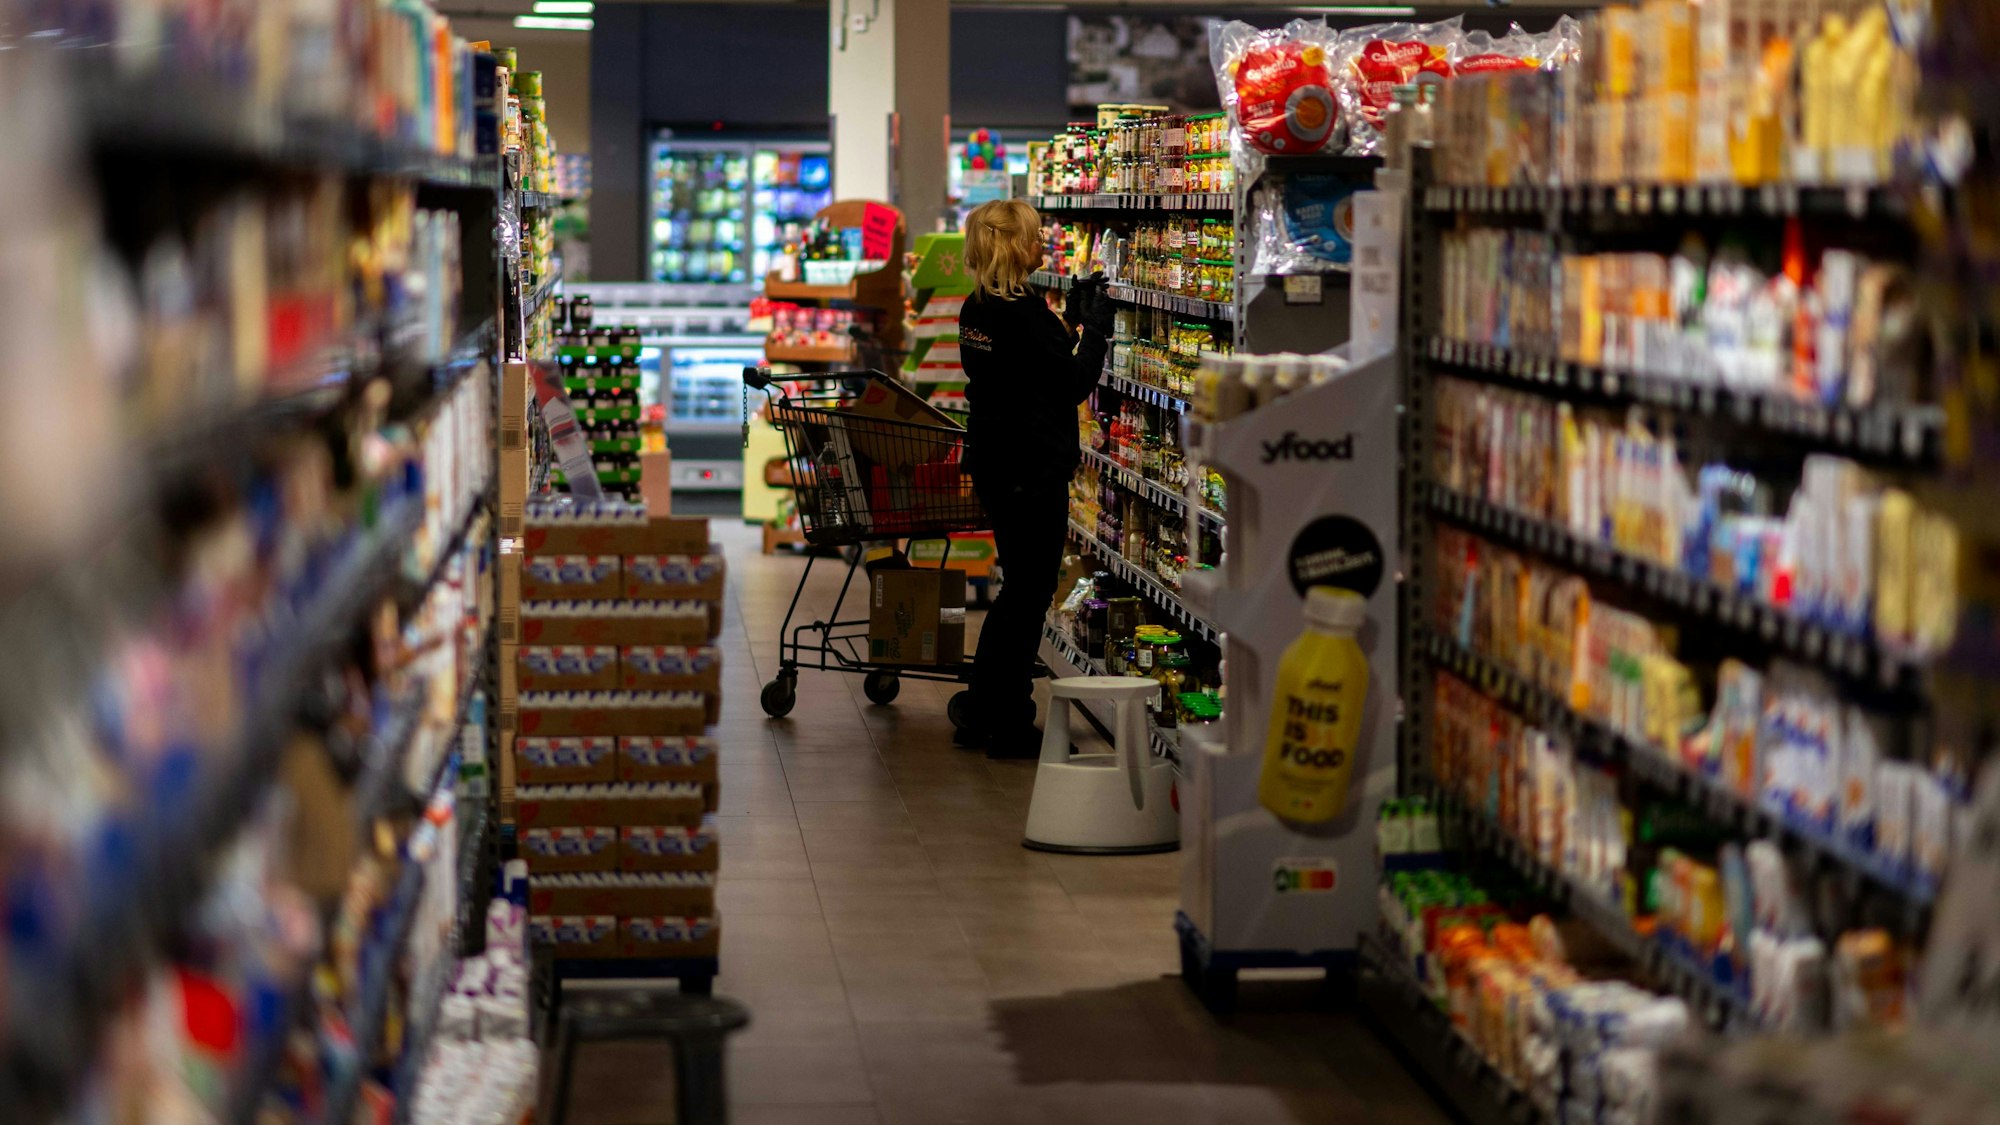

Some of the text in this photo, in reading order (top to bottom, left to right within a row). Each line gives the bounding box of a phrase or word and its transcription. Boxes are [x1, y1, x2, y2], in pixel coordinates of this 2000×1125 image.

[1371, 44, 1424, 62] Cafeclub
[1464, 56, 1517, 68] Cafeclub
[1246, 59, 1297, 80] Cafeclub
[1261, 431, 1354, 465] yfood
[1286, 695, 1339, 725] THIS
[1284, 719, 1307, 742] IS
[1280, 741, 1345, 770] FOOD
